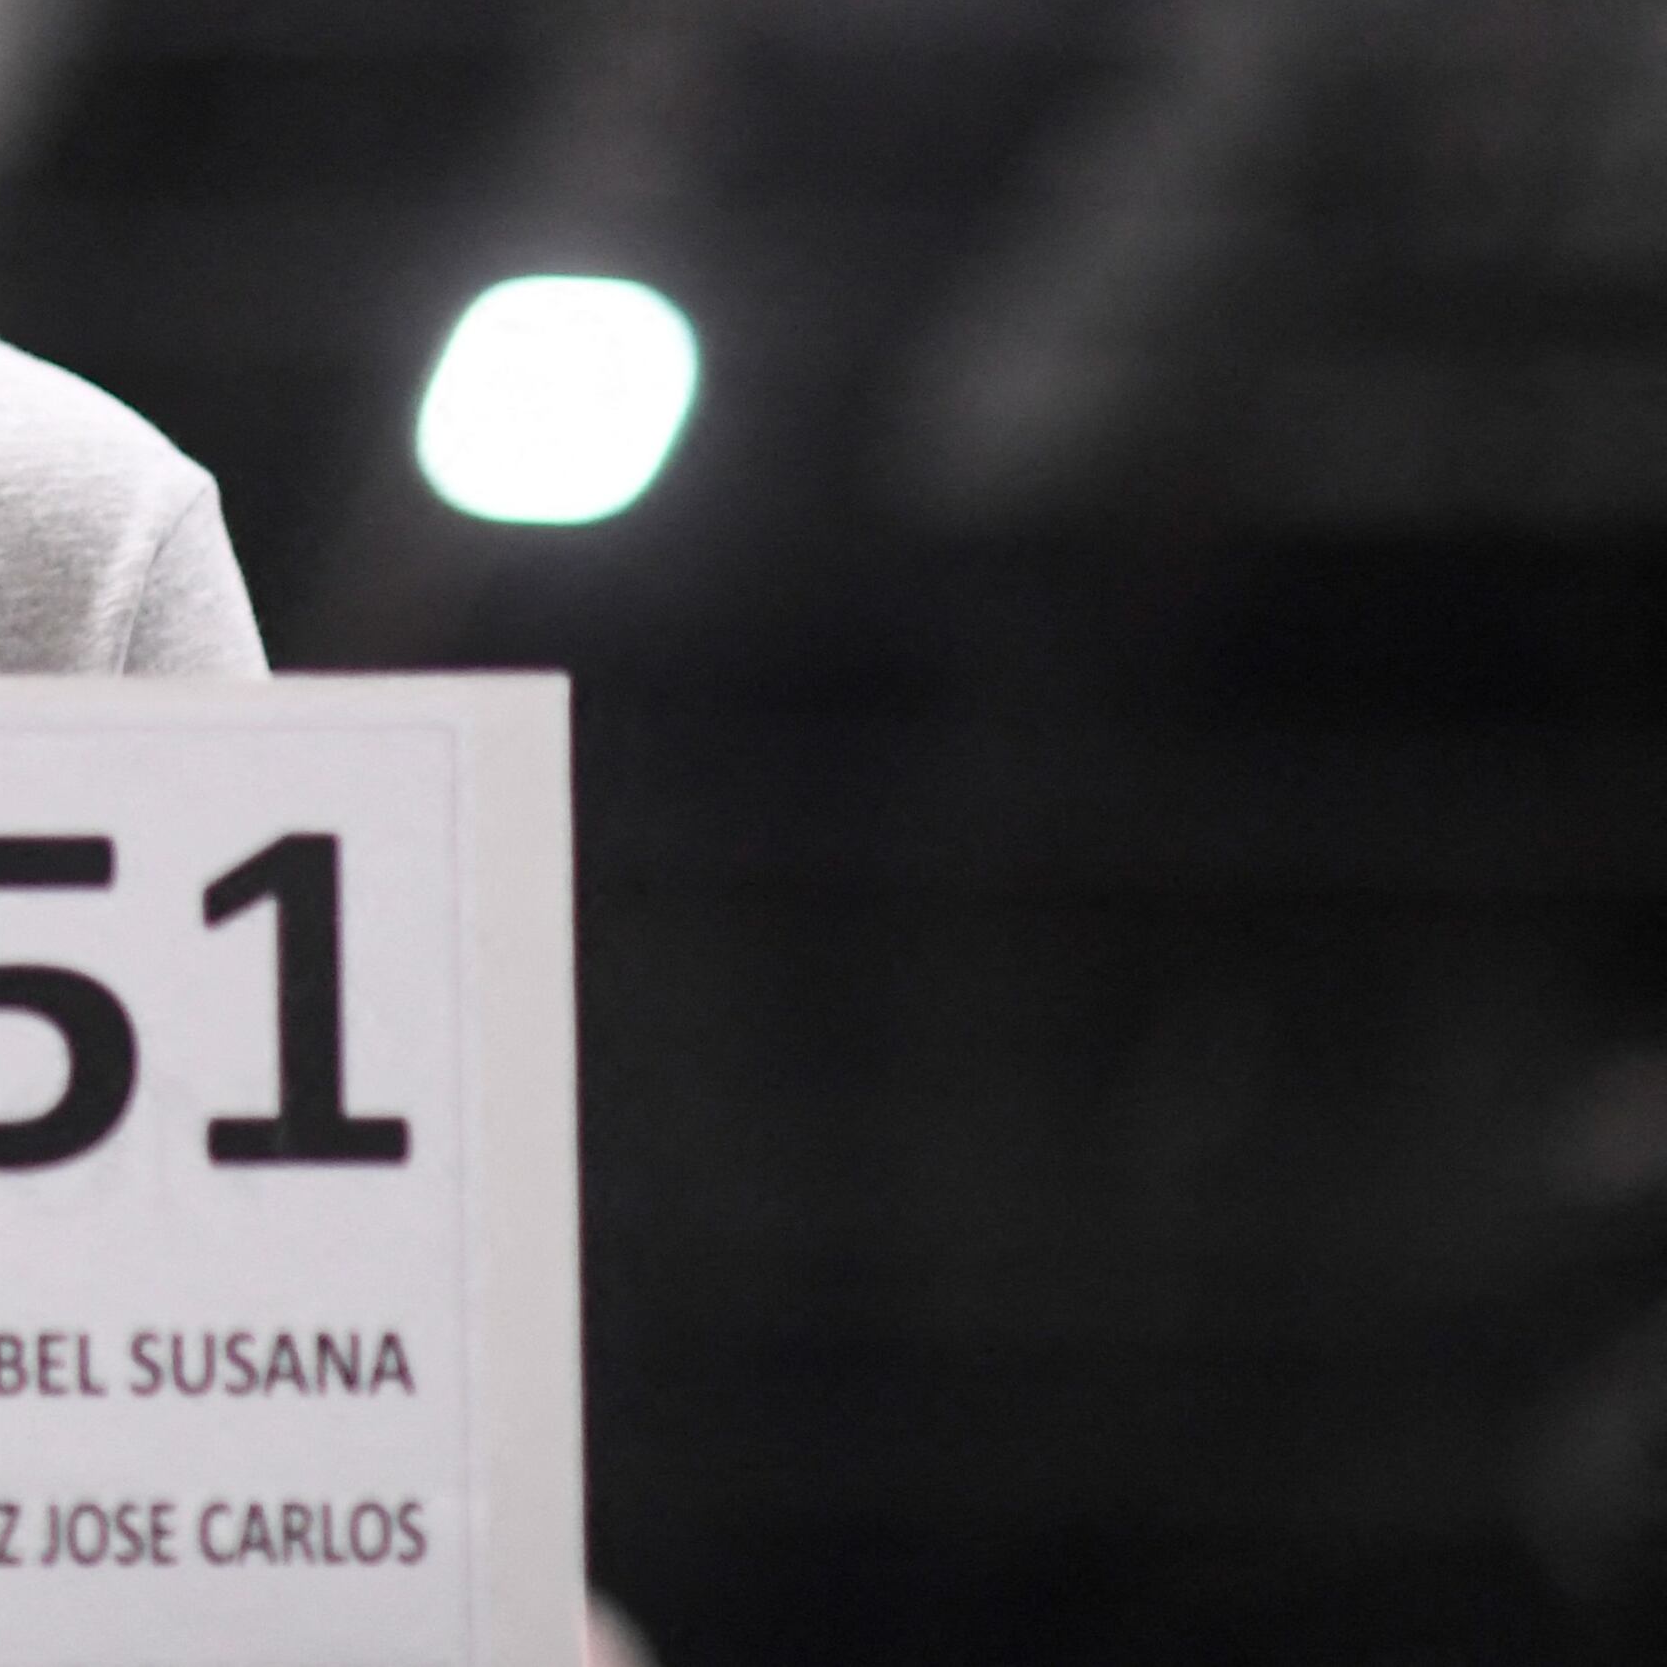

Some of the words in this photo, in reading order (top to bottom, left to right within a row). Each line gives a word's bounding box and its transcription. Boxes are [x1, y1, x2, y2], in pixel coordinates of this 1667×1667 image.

[128, 1329, 417, 1399] SUSANA
[37, 1498, 180, 1569] JOSE
[195, 1497, 430, 1569] CARLOS
